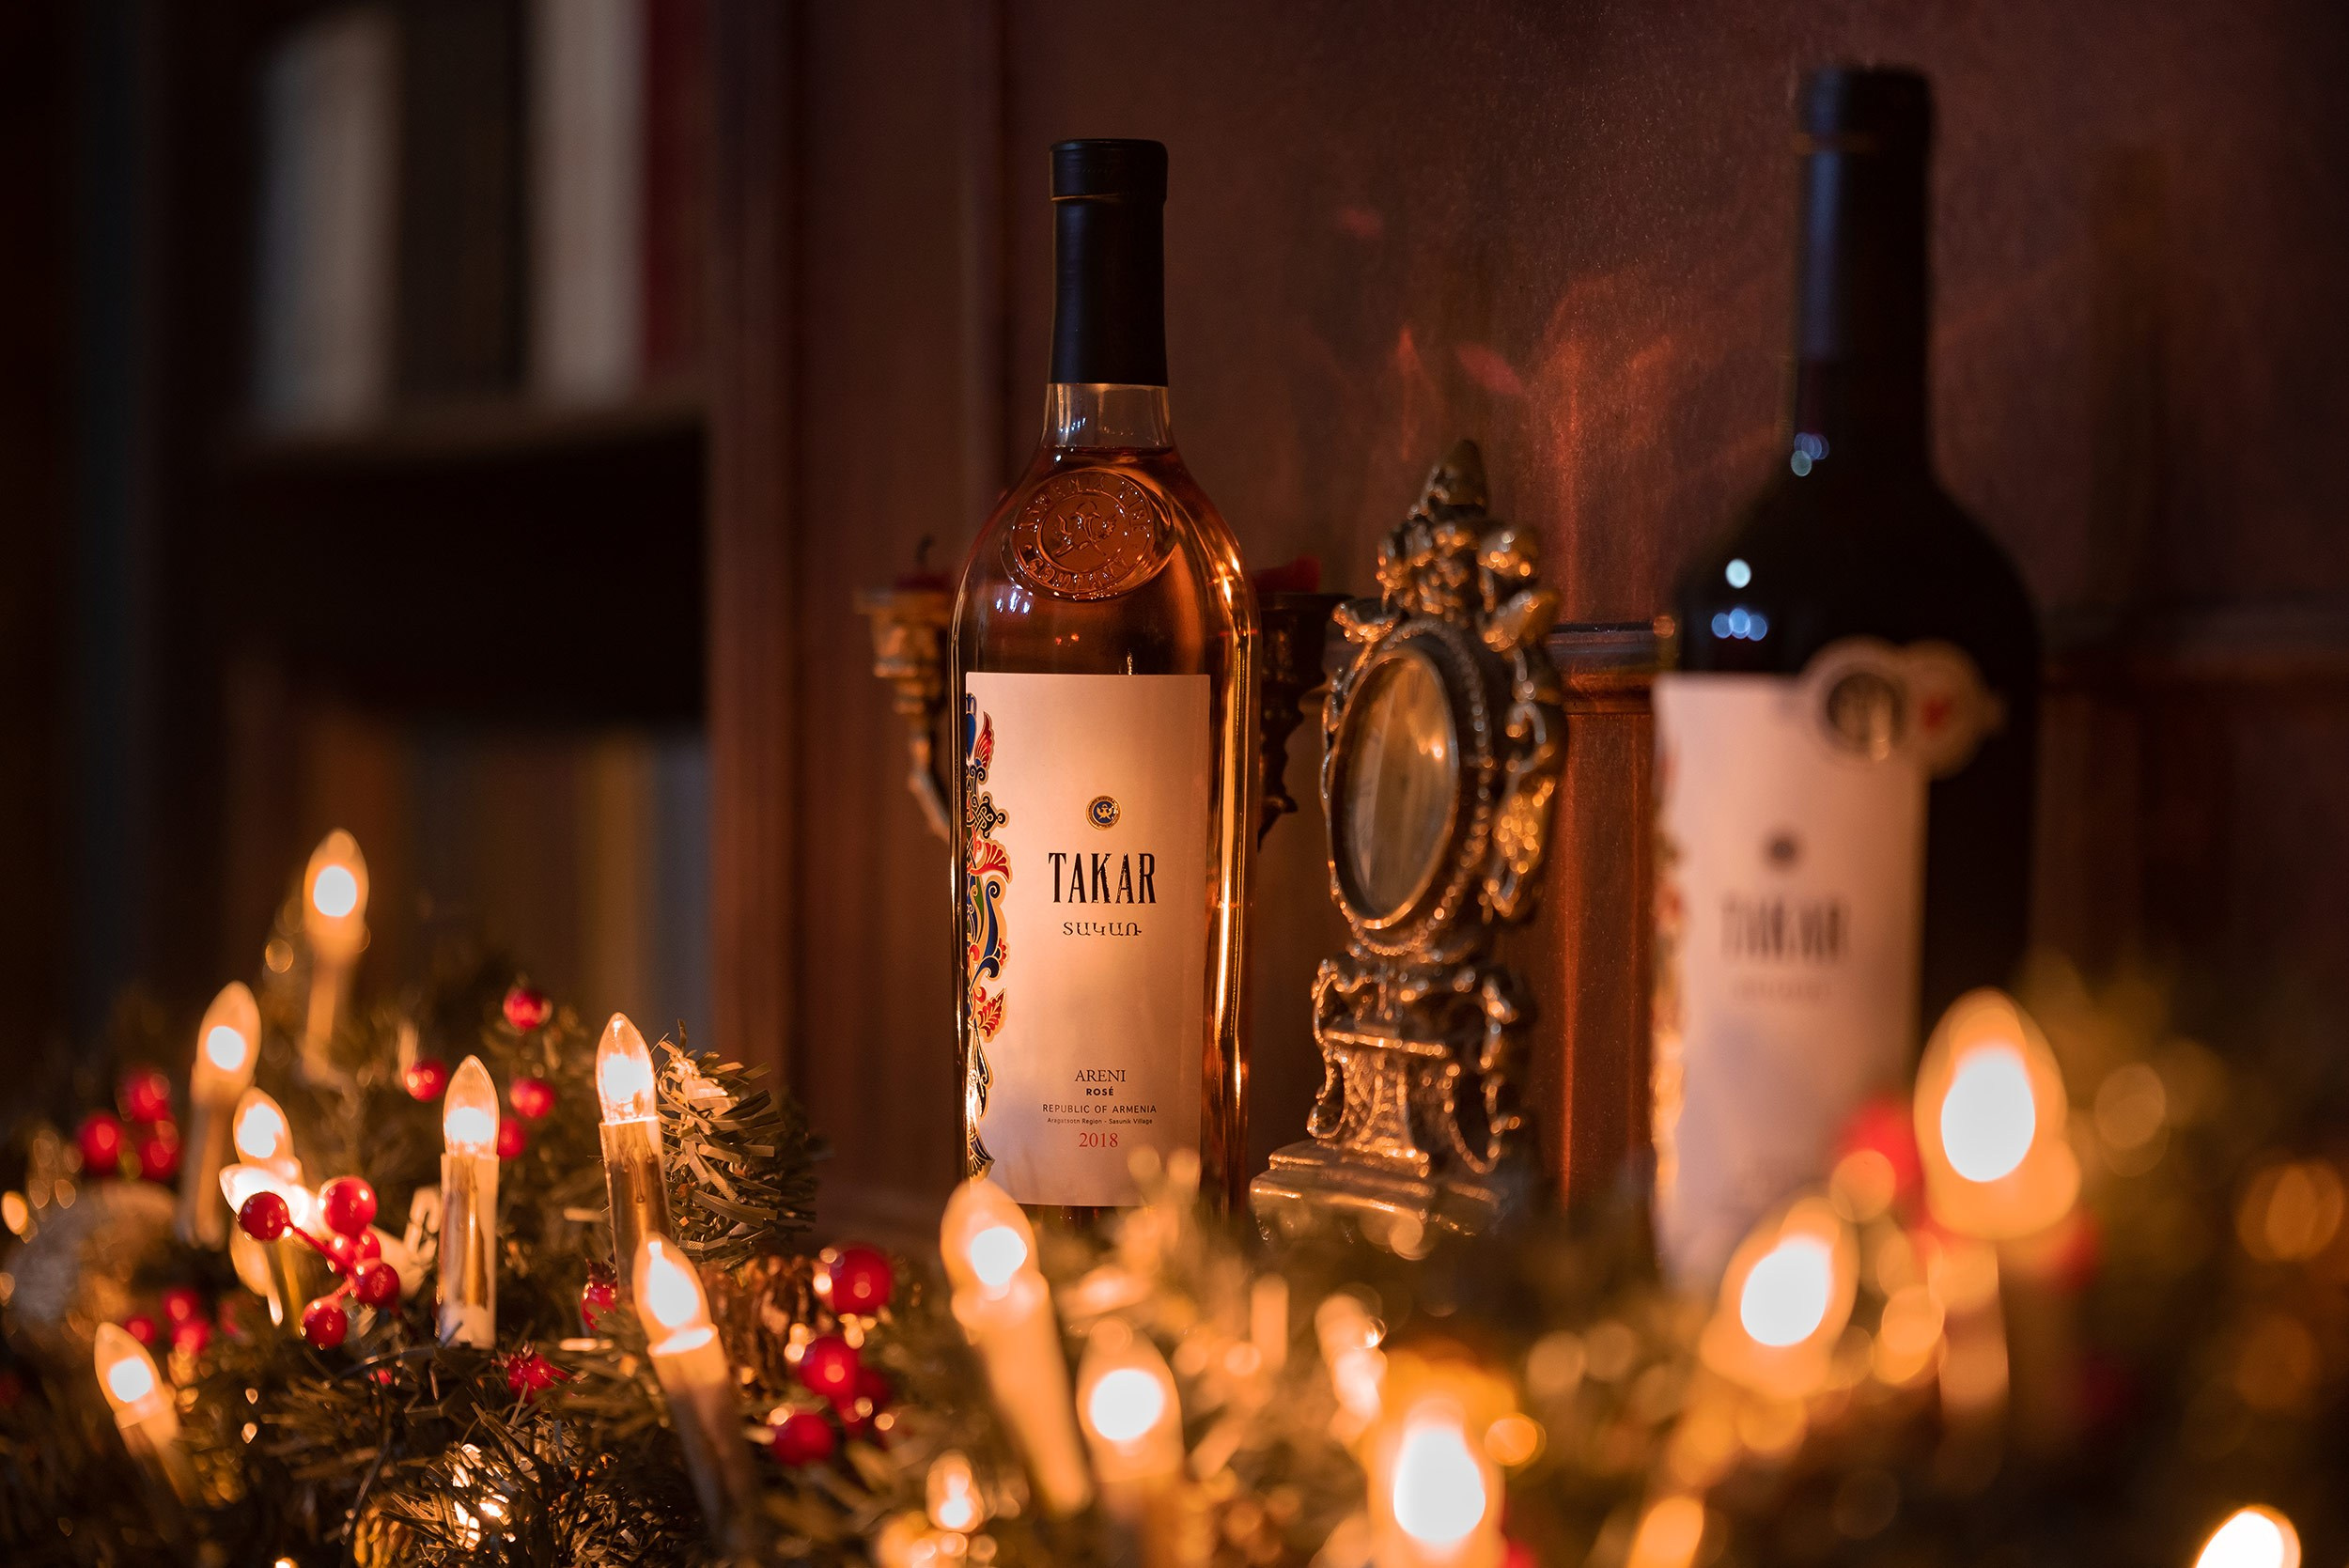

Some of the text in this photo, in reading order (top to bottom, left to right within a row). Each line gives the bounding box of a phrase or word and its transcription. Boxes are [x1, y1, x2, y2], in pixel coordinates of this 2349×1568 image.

[1048, 852, 1157, 904] TAKAR
[1074, 1069, 1127, 1082] ARENI
[1085, 1086, 1114, 1096] ROSÉ
[1042, 1104, 1158, 1114] REPUBLIC OF ARMENIA
[1081, 1118, 1103, 1126] Region
[1078, 1132, 1119, 1148] 2018
